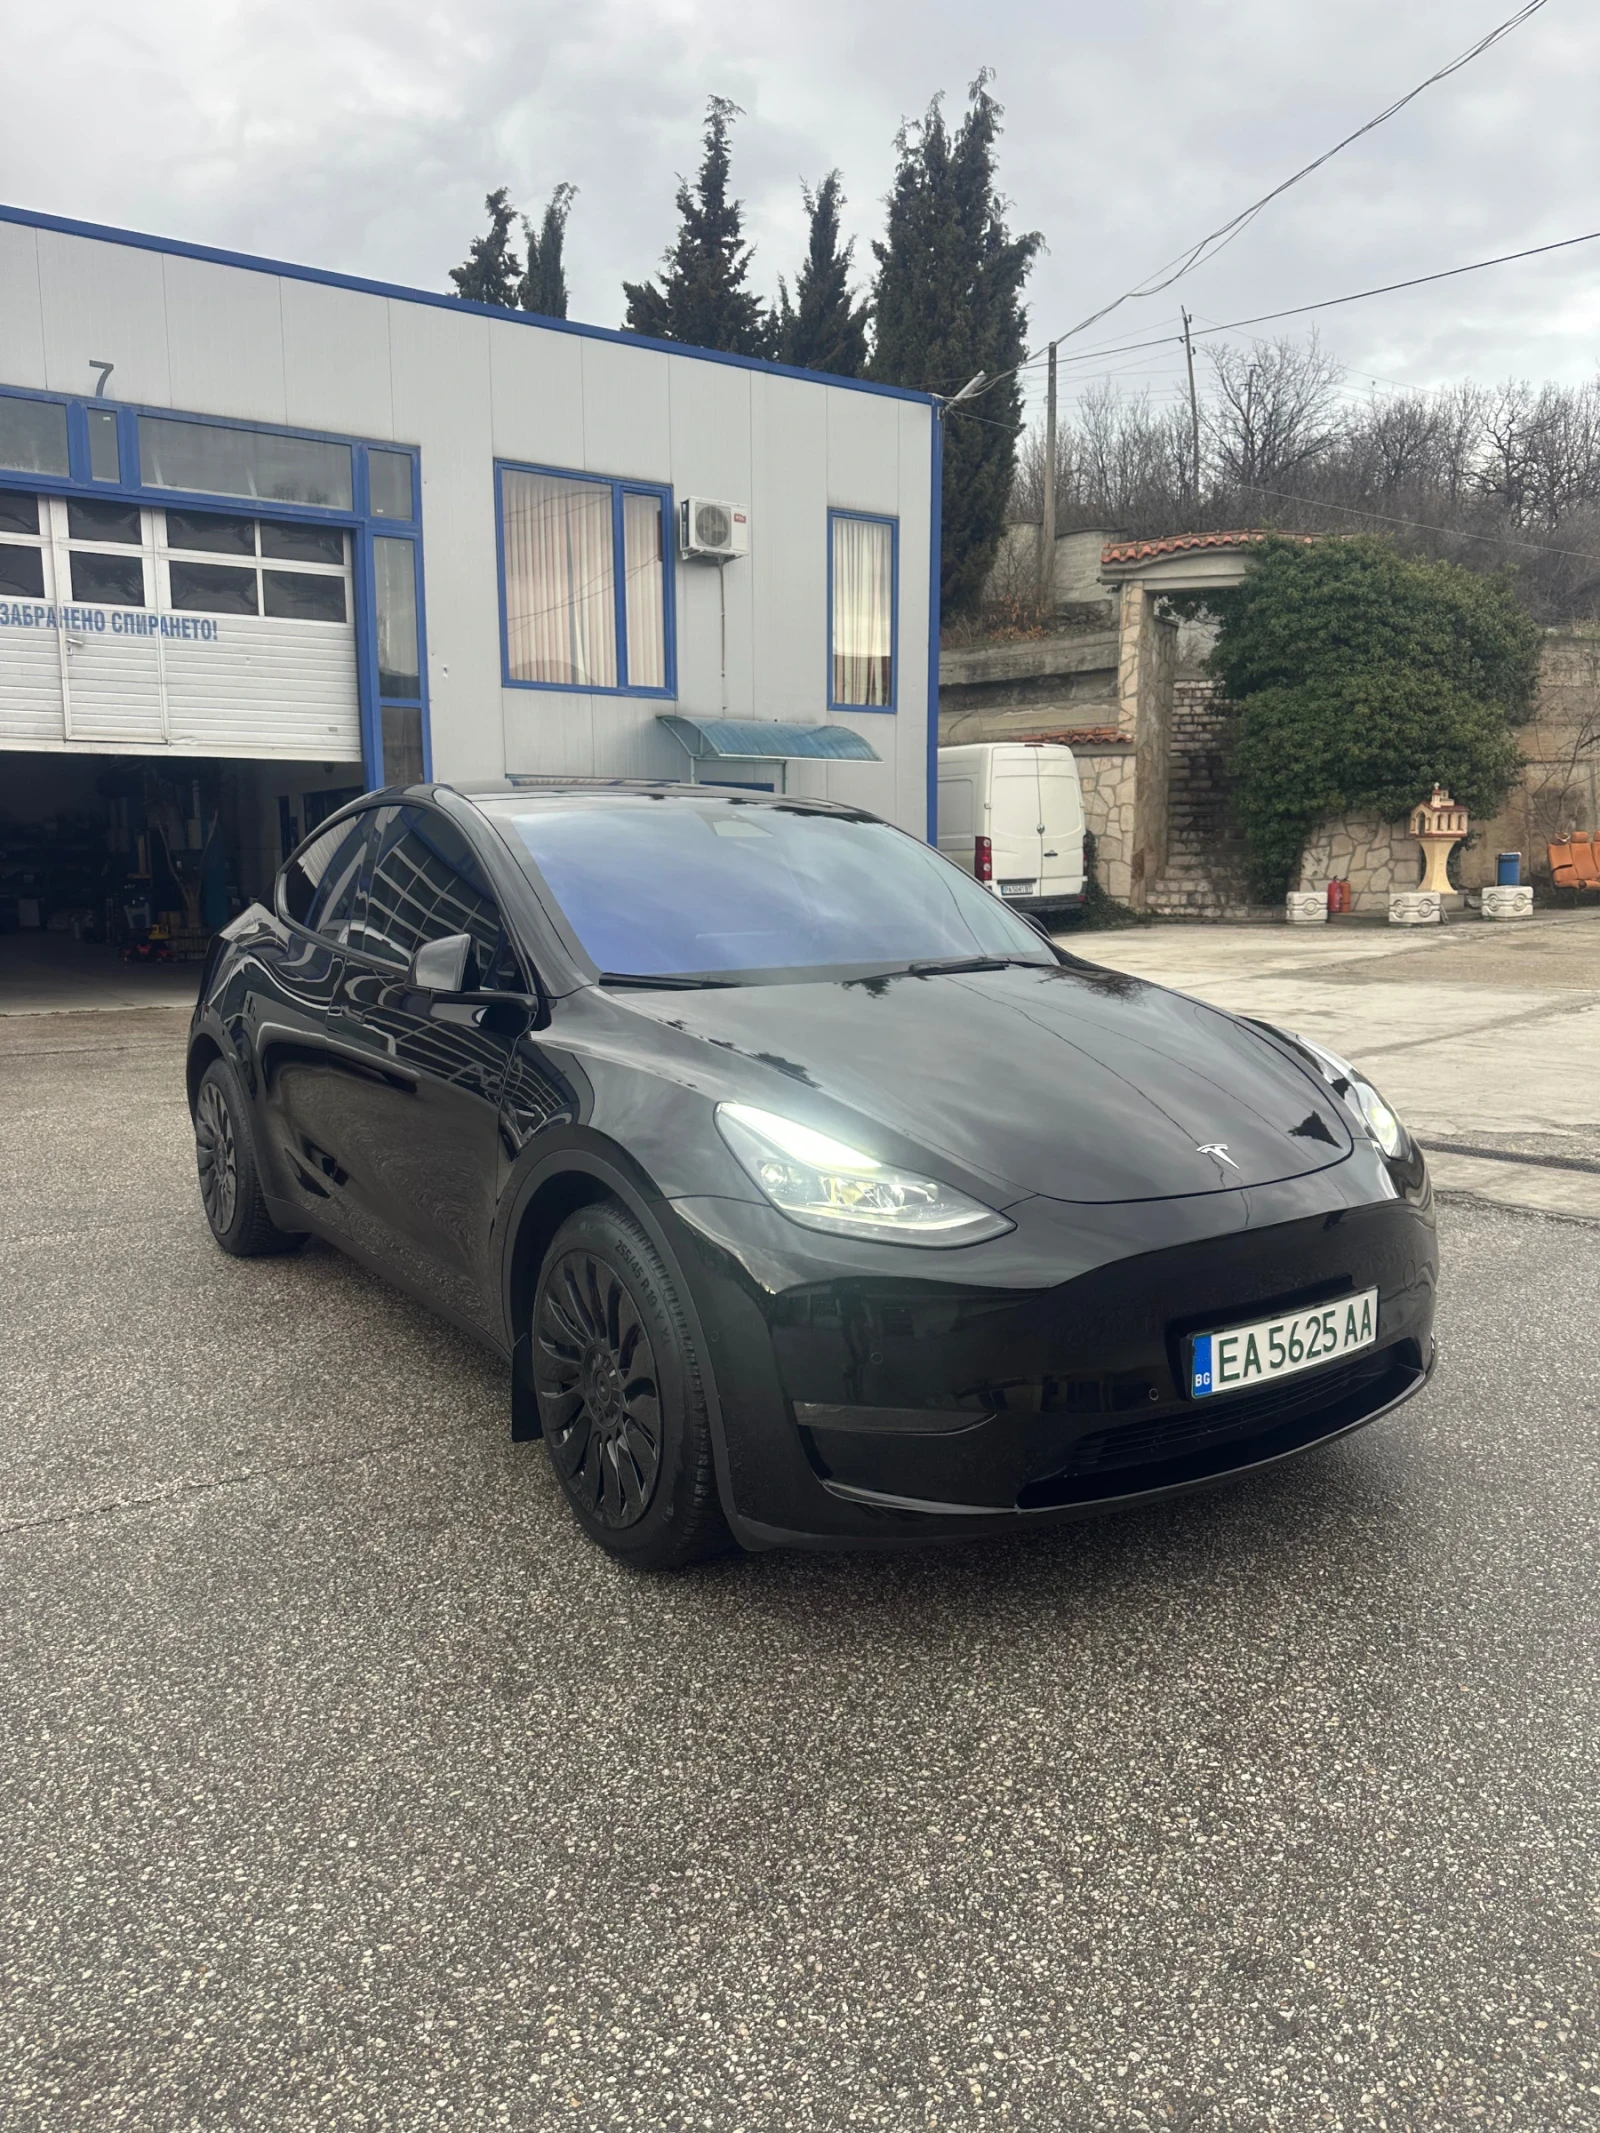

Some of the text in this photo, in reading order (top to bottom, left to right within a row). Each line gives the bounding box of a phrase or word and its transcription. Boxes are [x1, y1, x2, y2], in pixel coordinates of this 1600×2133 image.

[88, 359, 115, 399] 7
[0, 603, 218, 640] ЗАБРАНЕНО СПИРАНЕТО!
[615, 1240, 644, 1279] 255/45
[640, 1278, 650, 1292] R
[646, 1290, 657, 1308] 19
[1218, 1297, 1372, 1383] EA 5625 AA
[1194, 1372, 1211, 1388] BG
